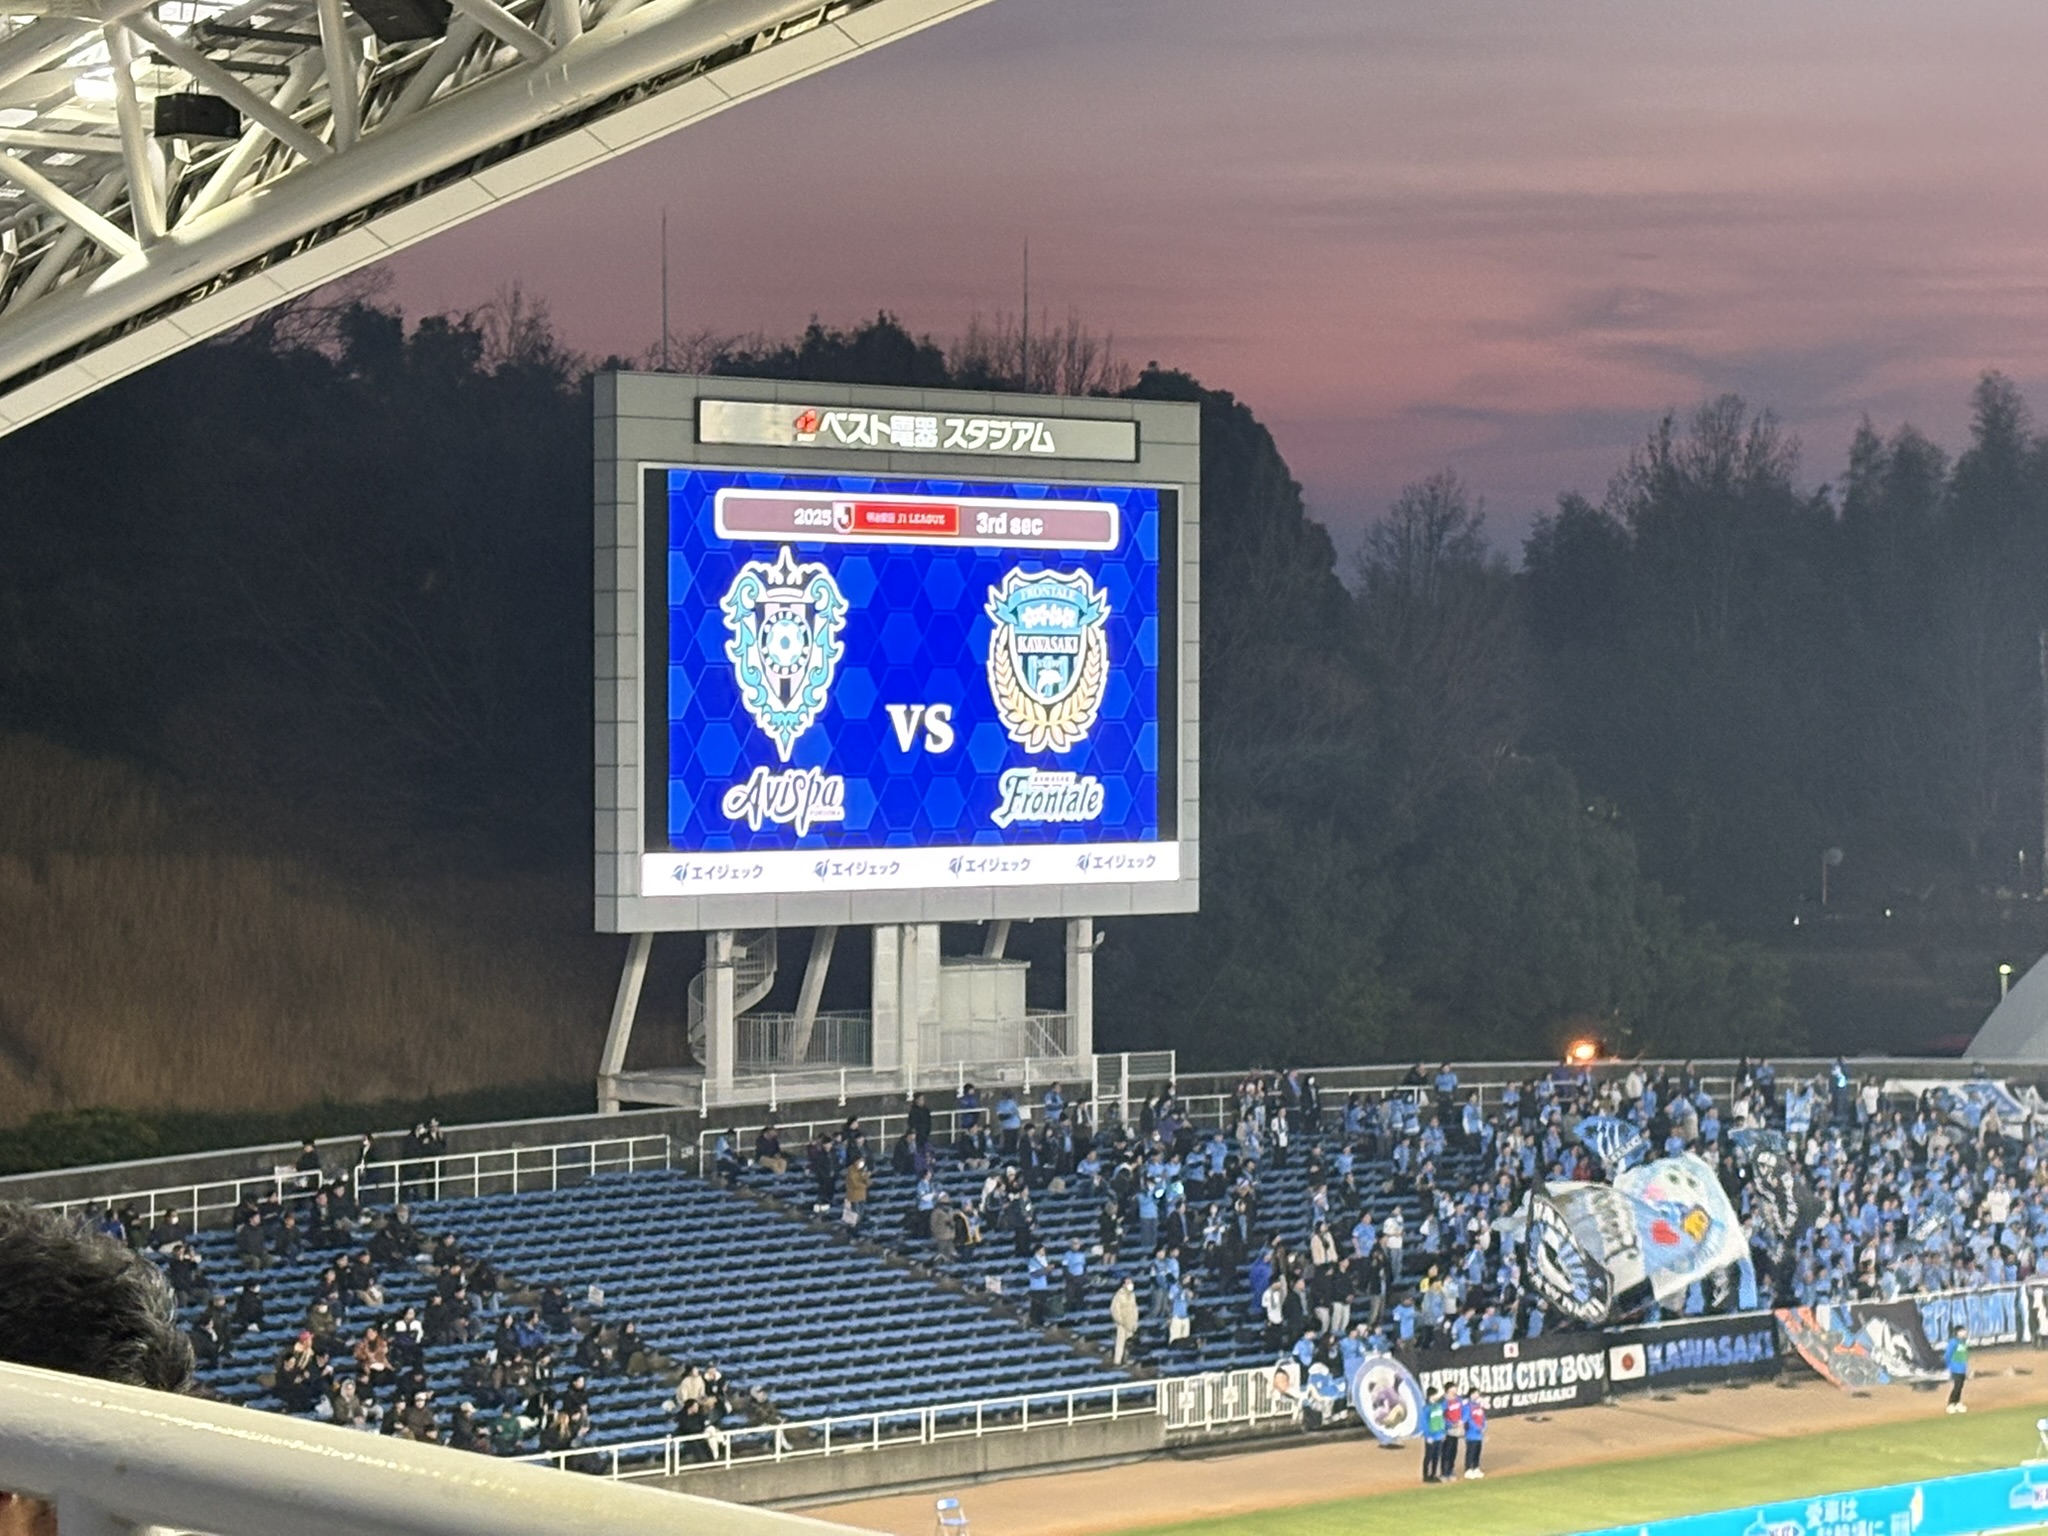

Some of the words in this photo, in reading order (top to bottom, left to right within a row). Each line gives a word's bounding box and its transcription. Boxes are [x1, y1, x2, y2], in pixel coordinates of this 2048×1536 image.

[819, 411, 938, 448] ベスト電器
[943, 418, 1056, 453] スタジアム
[794, 508, 832, 526] 2025
[976, 511, 1008, 534] 3rd
[1009, 517, 1044, 536] sec
[1017, 635, 1078, 653] KAWASAKI
[885, 704, 954, 753] VS
[725, 769, 841, 833] Avispa
[998, 774, 1101, 820] Frontale
[691, 864, 763, 880] エイジェック
[831, 861, 900, 876] エイジェック
[965, 858, 1031, 873] エイジェック
[1092, 855, 1156, 869] エイジェック
[1647, 1330, 1774, 1376] KAWASAKI
[1516, 1358, 1558, 1391] CITY
